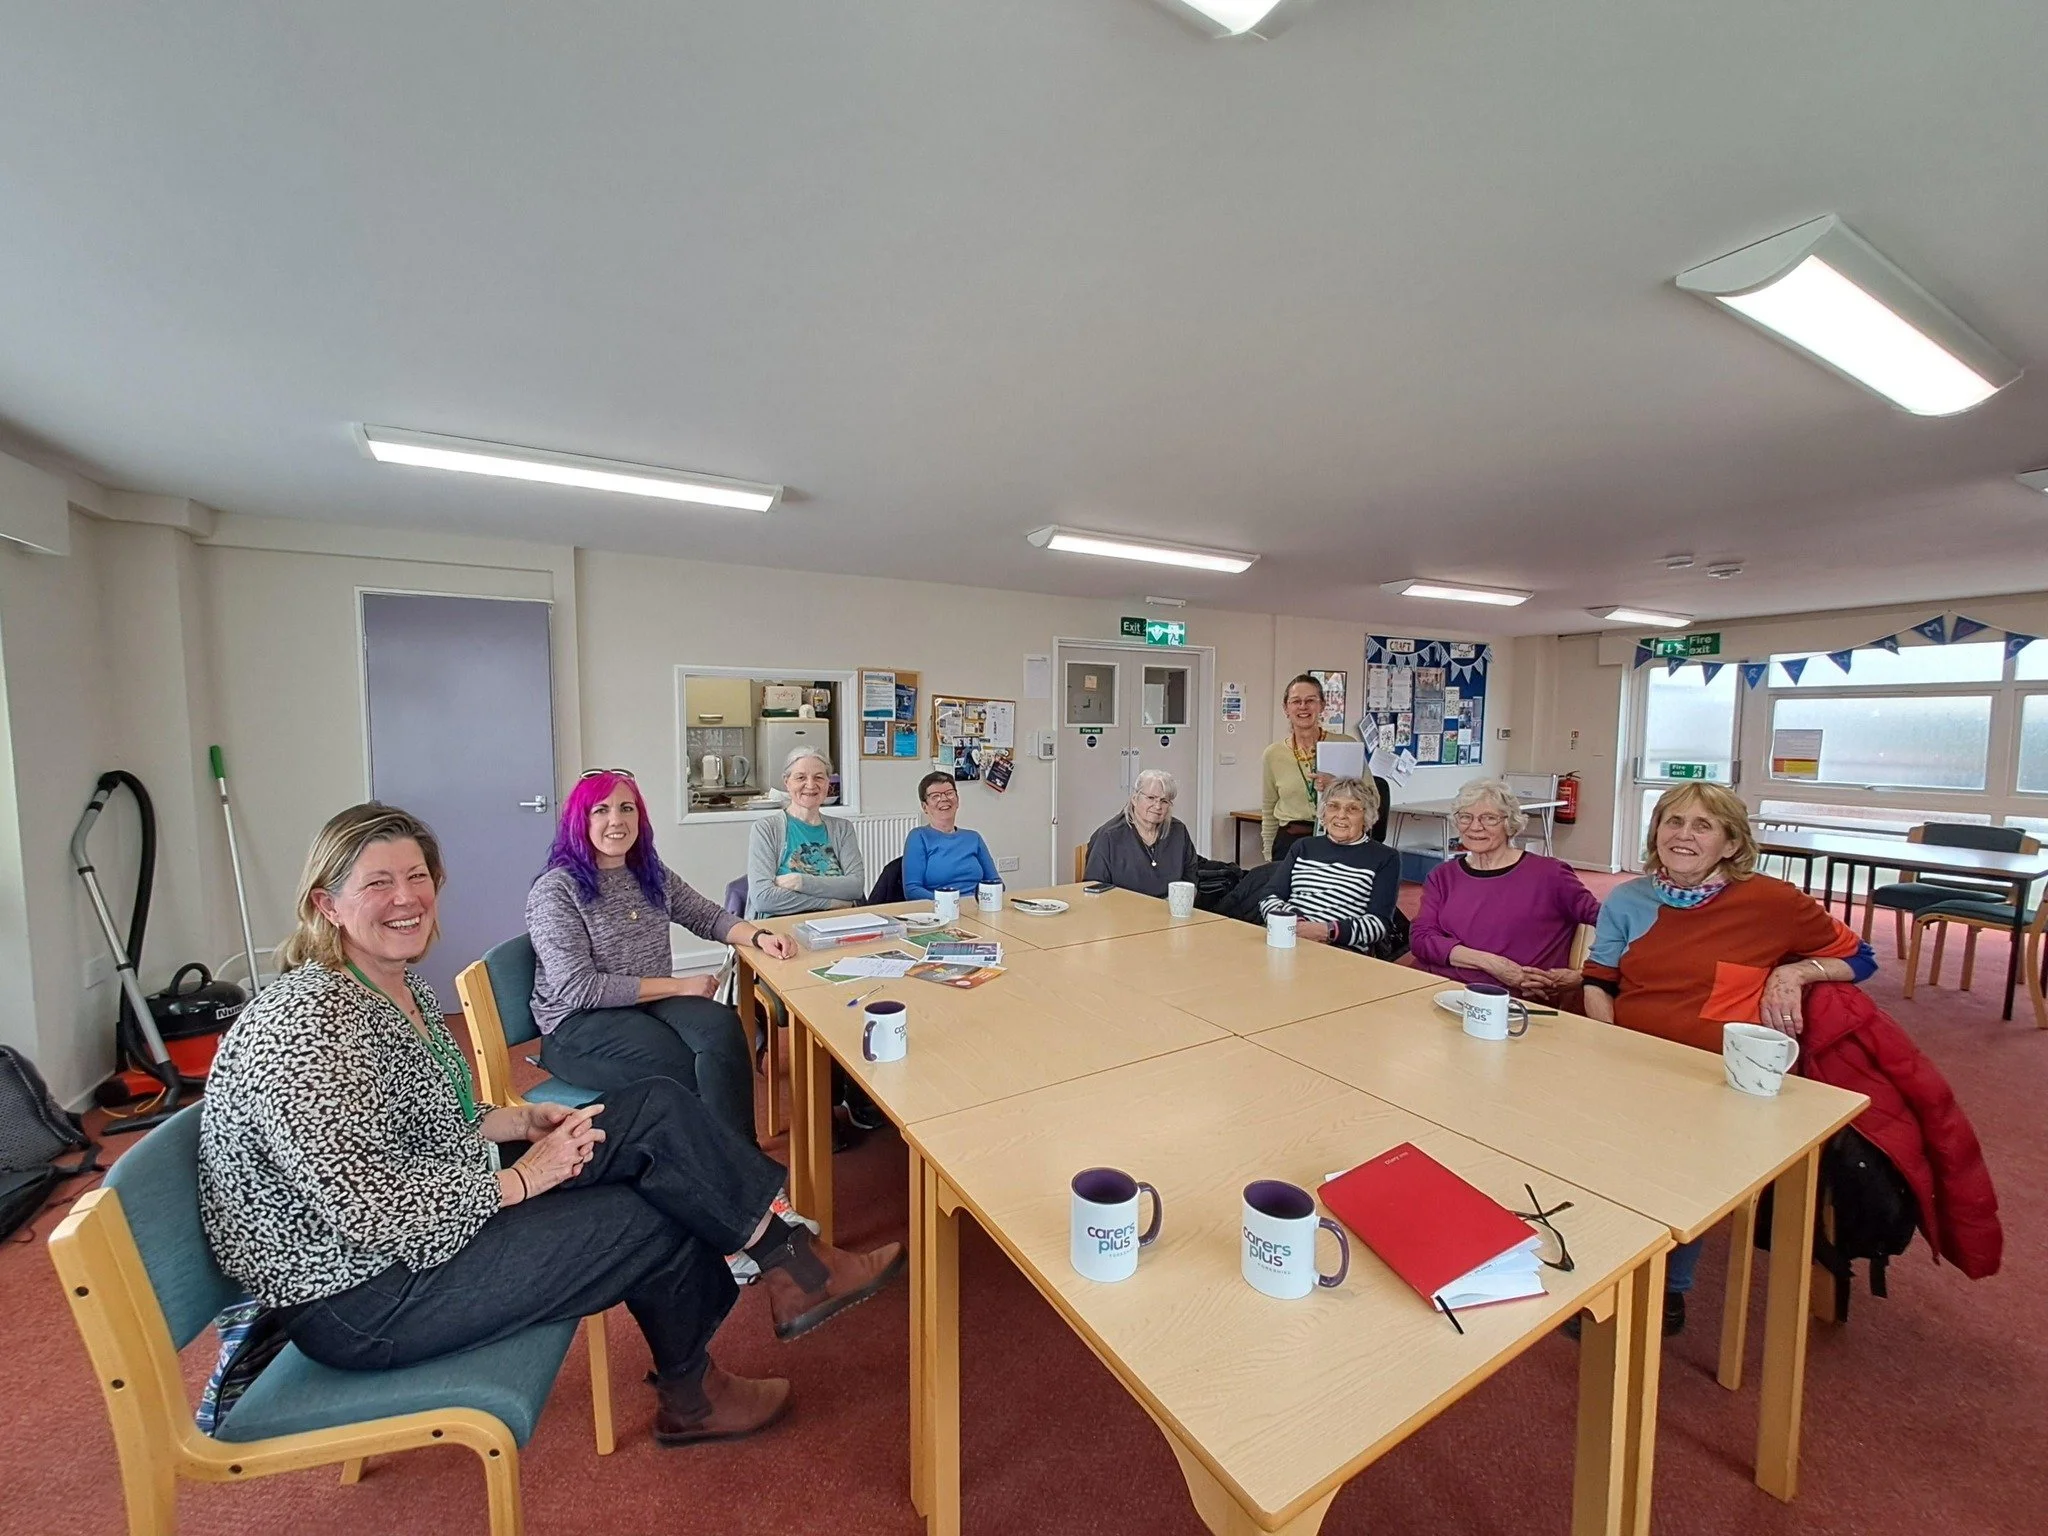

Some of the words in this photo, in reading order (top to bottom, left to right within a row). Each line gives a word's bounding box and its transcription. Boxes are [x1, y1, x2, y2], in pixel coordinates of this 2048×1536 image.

[1123, 621, 1140, 632] Exit
[1389, 640, 1412, 651] CRAFT
[1689, 635, 1712, 645] Fire
[1689, 645, 1711, 655] exit
[1087, 1221, 1135, 1240] carers
[1098, 1236, 1131, 1255] plus
[1243, 1225, 1292, 1257] carers
[1250, 1244, 1283, 1267] plus
